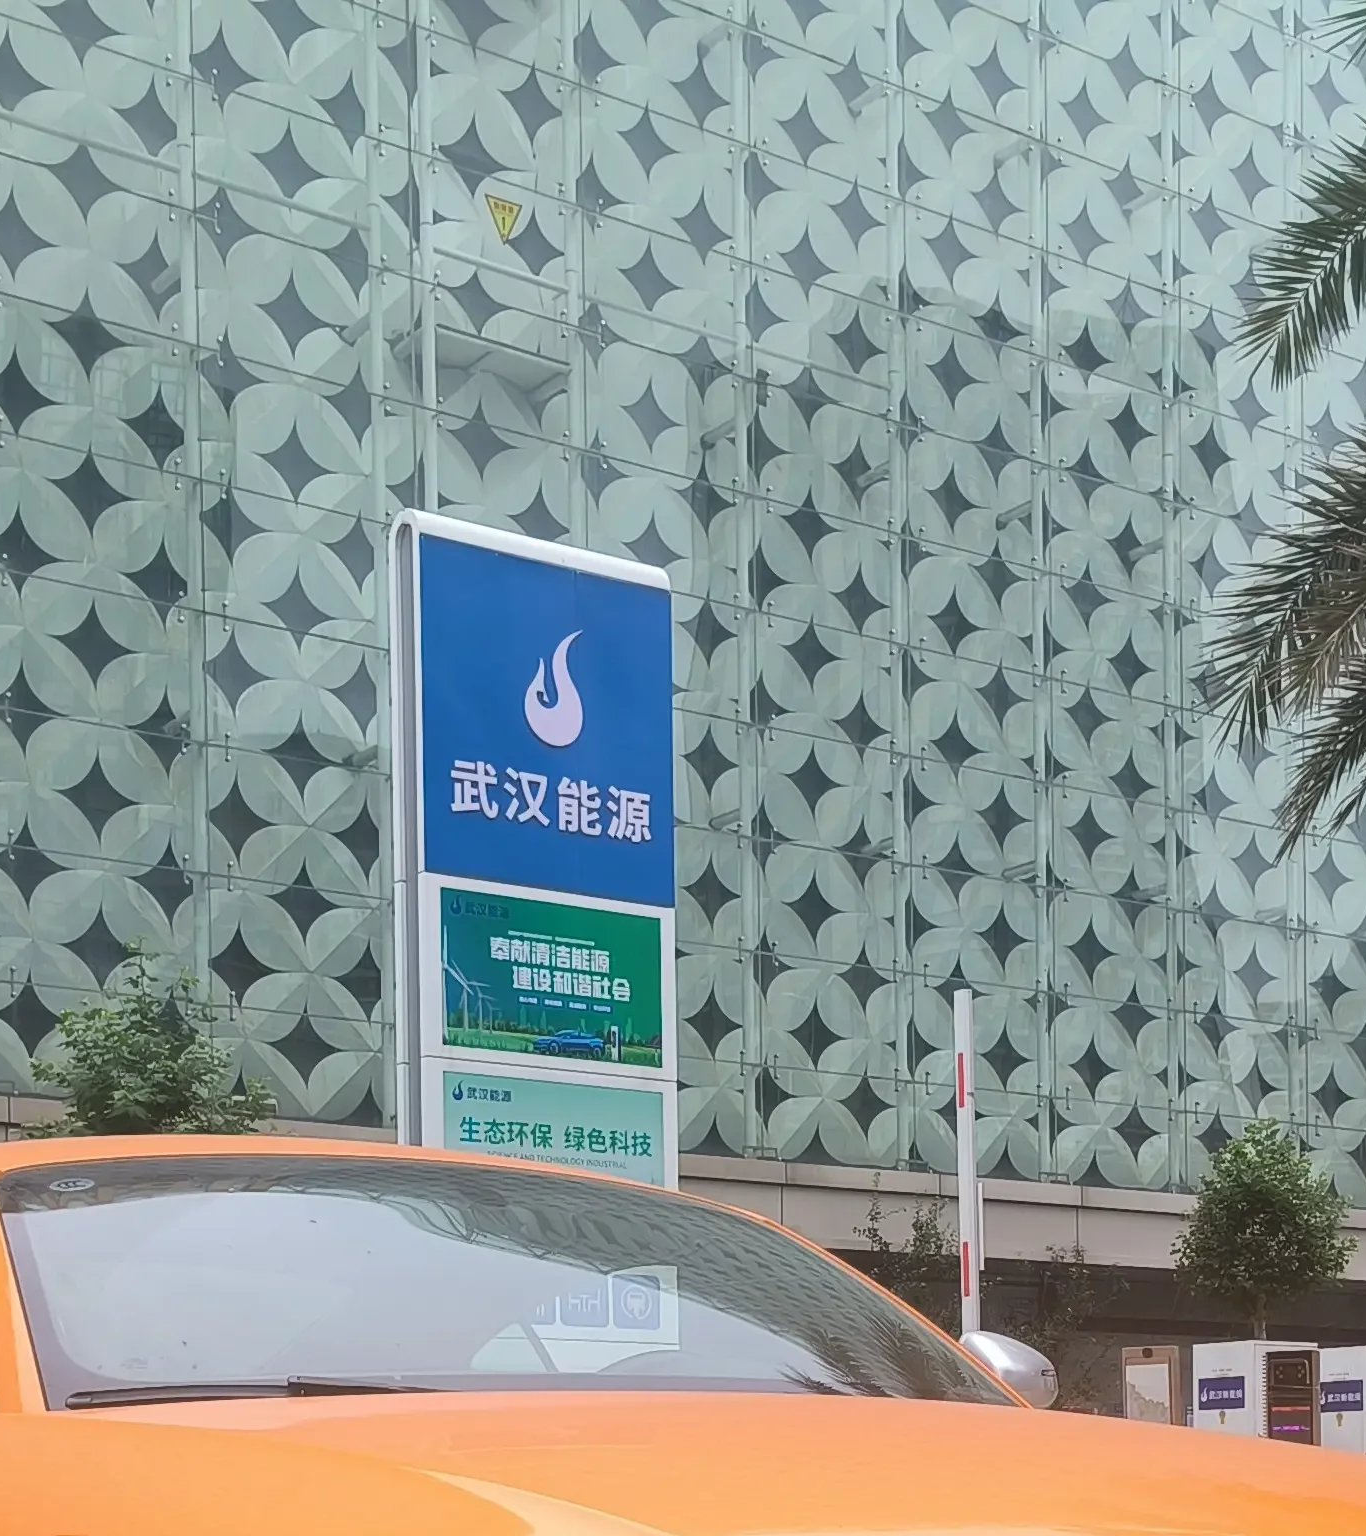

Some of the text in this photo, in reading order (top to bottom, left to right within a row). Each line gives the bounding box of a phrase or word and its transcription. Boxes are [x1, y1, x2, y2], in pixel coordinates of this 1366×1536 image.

[450, 760, 653, 844] 武汉能源
[490, 936, 610, 974] 奉献清洁能源
[512, 965, 631, 1002] 建设和谐社会
[459, 1116, 653, 1158] 生态环保 绿色科技
